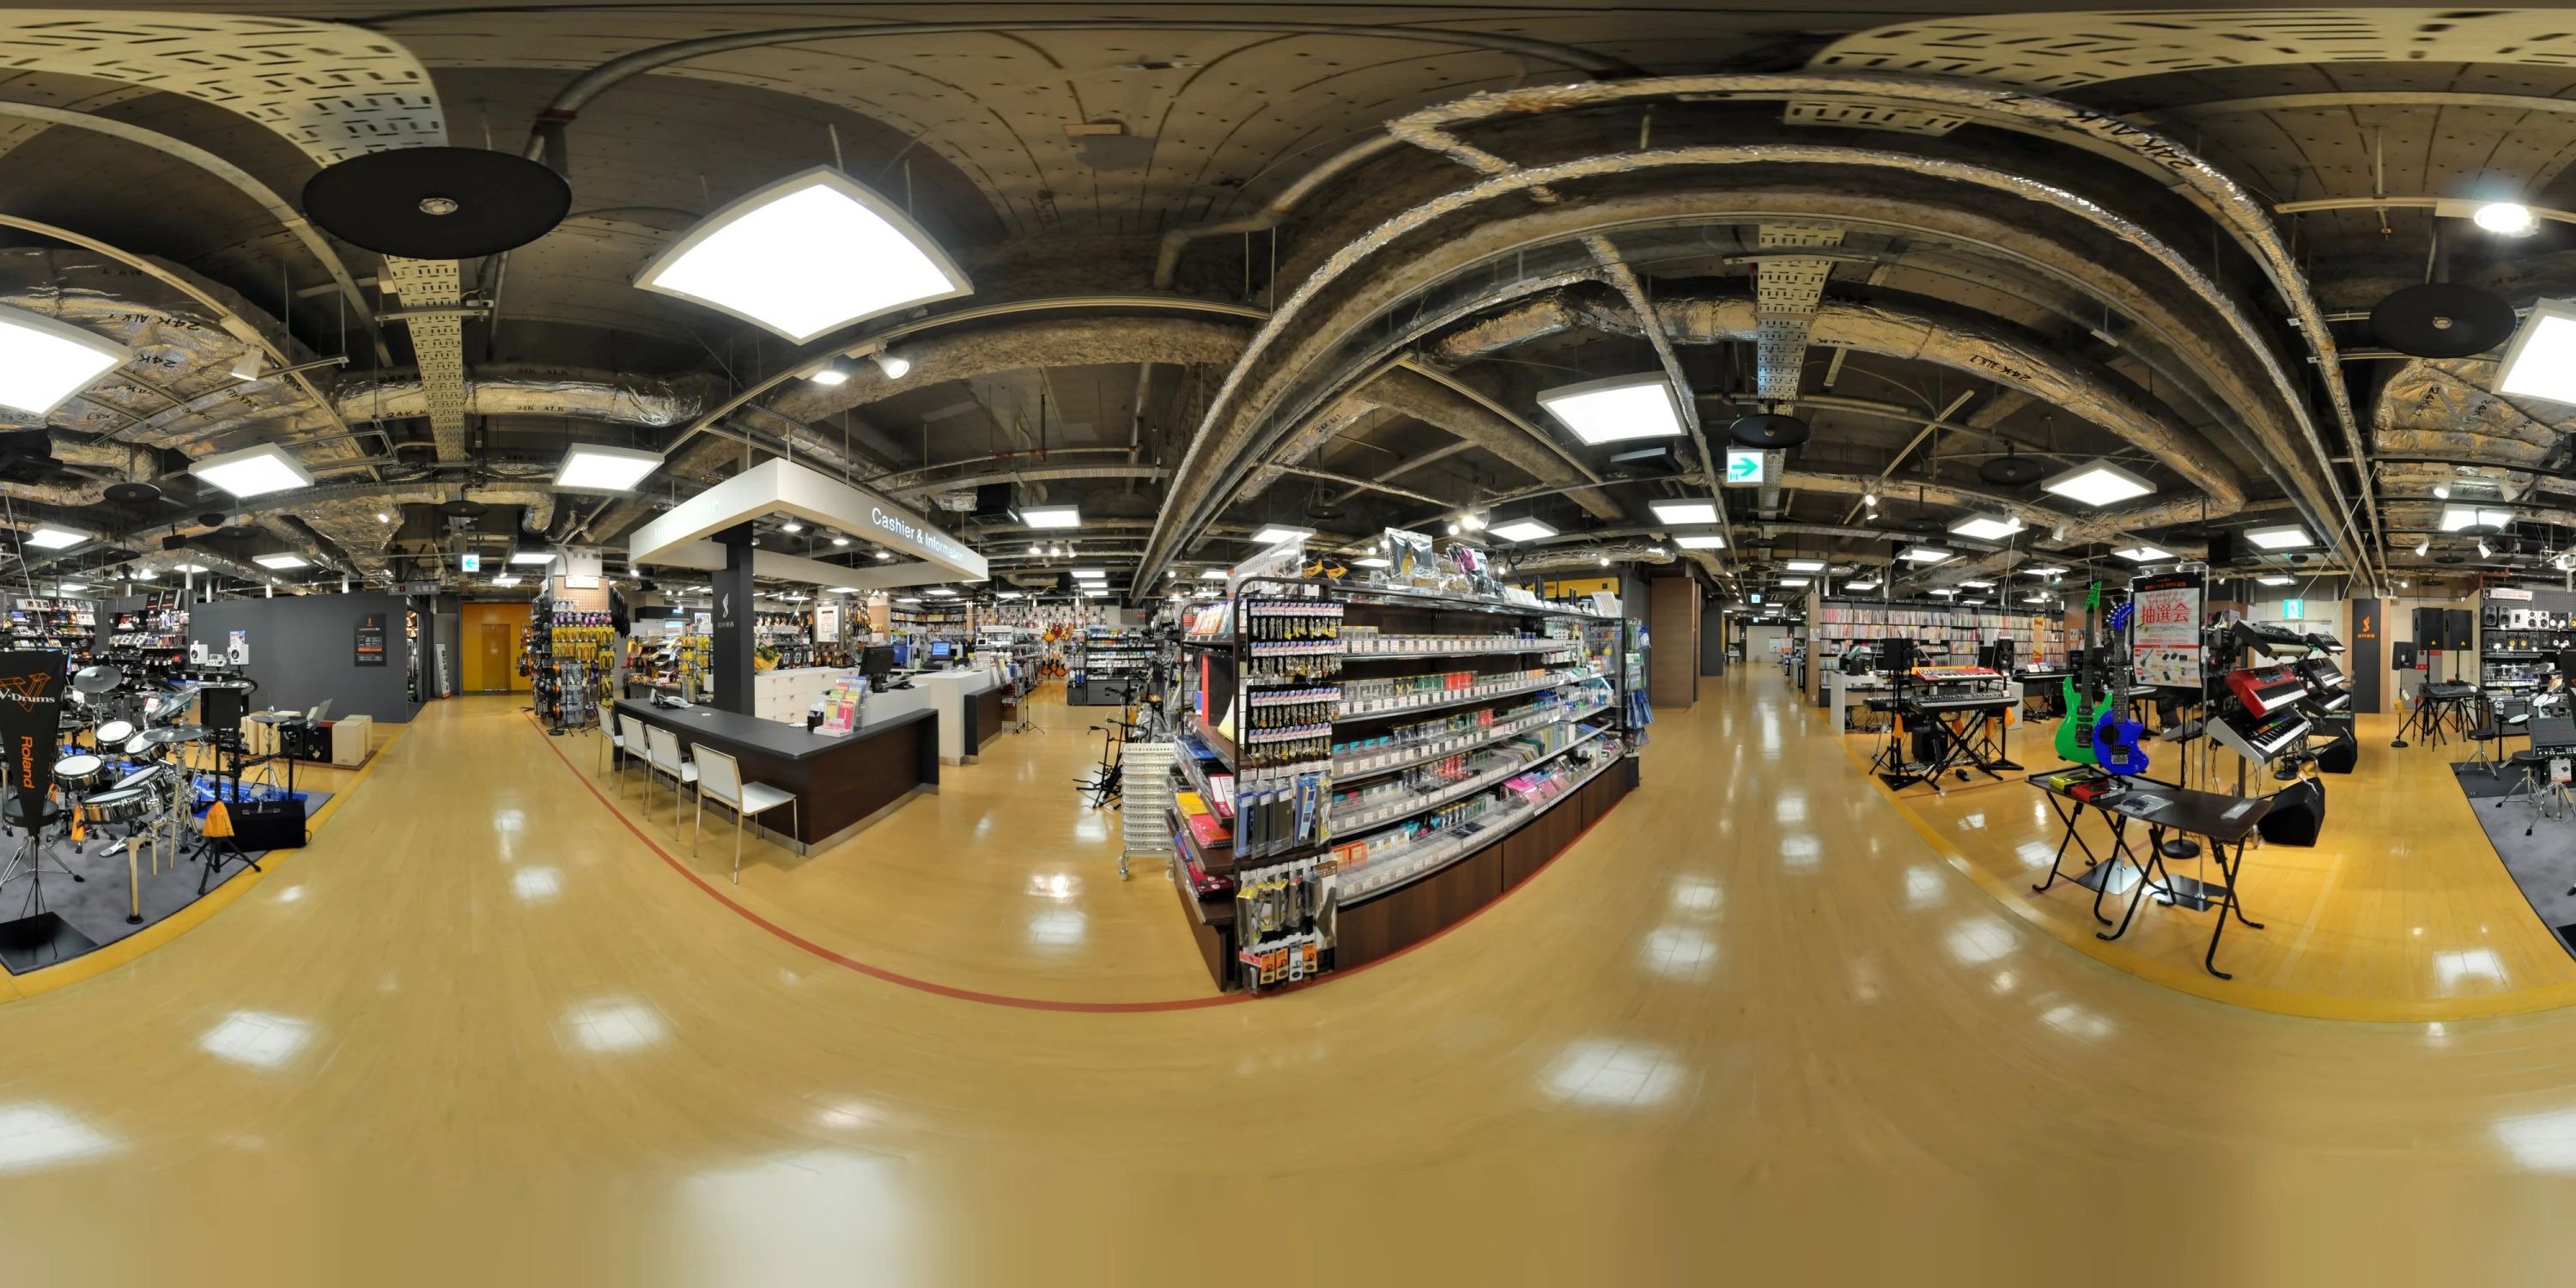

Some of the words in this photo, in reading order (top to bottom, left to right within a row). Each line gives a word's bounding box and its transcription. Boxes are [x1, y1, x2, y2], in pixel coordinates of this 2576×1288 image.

[122, 313, 149, 324] ALK
[156, 316, 203, 331] 24K
[137, 353, 177, 368] 24K
[2002, 365, 2032, 382] 24K
[872, 507, 915, 539] Cashier
[916, 528, 924, 544] &
[2142, 602, 2191, 623] 抽選会
[21, 736, 35, 788] Roland
